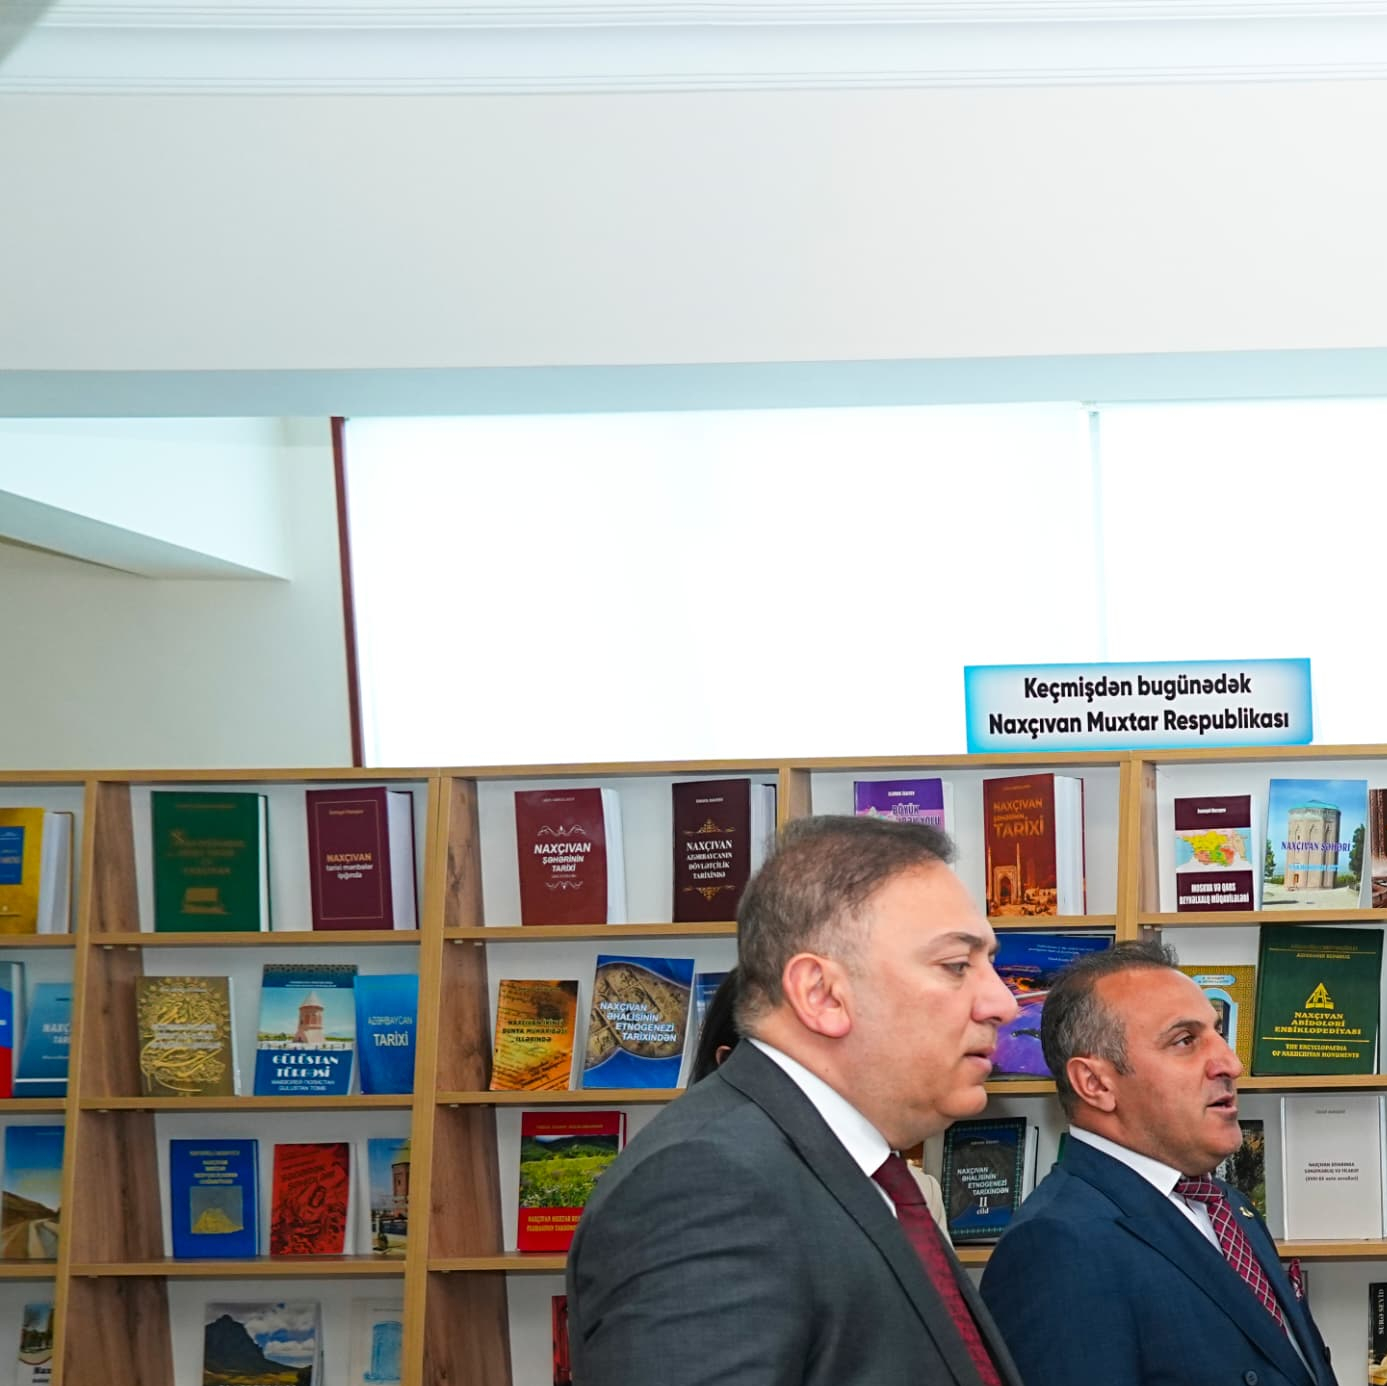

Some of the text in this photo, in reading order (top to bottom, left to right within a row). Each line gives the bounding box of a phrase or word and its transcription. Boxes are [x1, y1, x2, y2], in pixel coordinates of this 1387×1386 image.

[1024, 673, 1252, 703] Keçmişdən bugünədək
[989, 708, 1289, 739] Naxçıvan Muxtar Respublikası
[993, 798, 1043, 813] NAXÇIVAN
[993, 816, 1044, 838] TARİXİ
[534, 843, 591, 855] NAXÇIVAN
[686, 839, 733, 851] NAXÇIVAN
[1281, 841, 1319, 852] NAXÇIVAN
[326, 853, 373, 864] NAXÇIVAN
[542, 855, 584, 865] ŞƏHƏRİNİN
[551, 863, 576, 872] TARİXİ
[600, 1002, 648, 1012] NAXÇIVAN
[367, 1016, 413, 1025] AZƏRBAYCAN
[606, 1012, 659, 1022] ƏHALİSİNİN
[1294, 1012, 1343, 1020] NAXÇIVAN
[615, 1022, 675, 1032] ETNOGENEZİ
[1274, 1026, 1361, 1035] ENSİKLOPEDİYASI
[373, 1032, 410, 1048] TARİXİ
[272, 1053, 339, 1066] GÜLÜSTAN
[957, 1167, 989, 1175] NAXÇIVAN
[976, 1207, 989, 1215] cild
